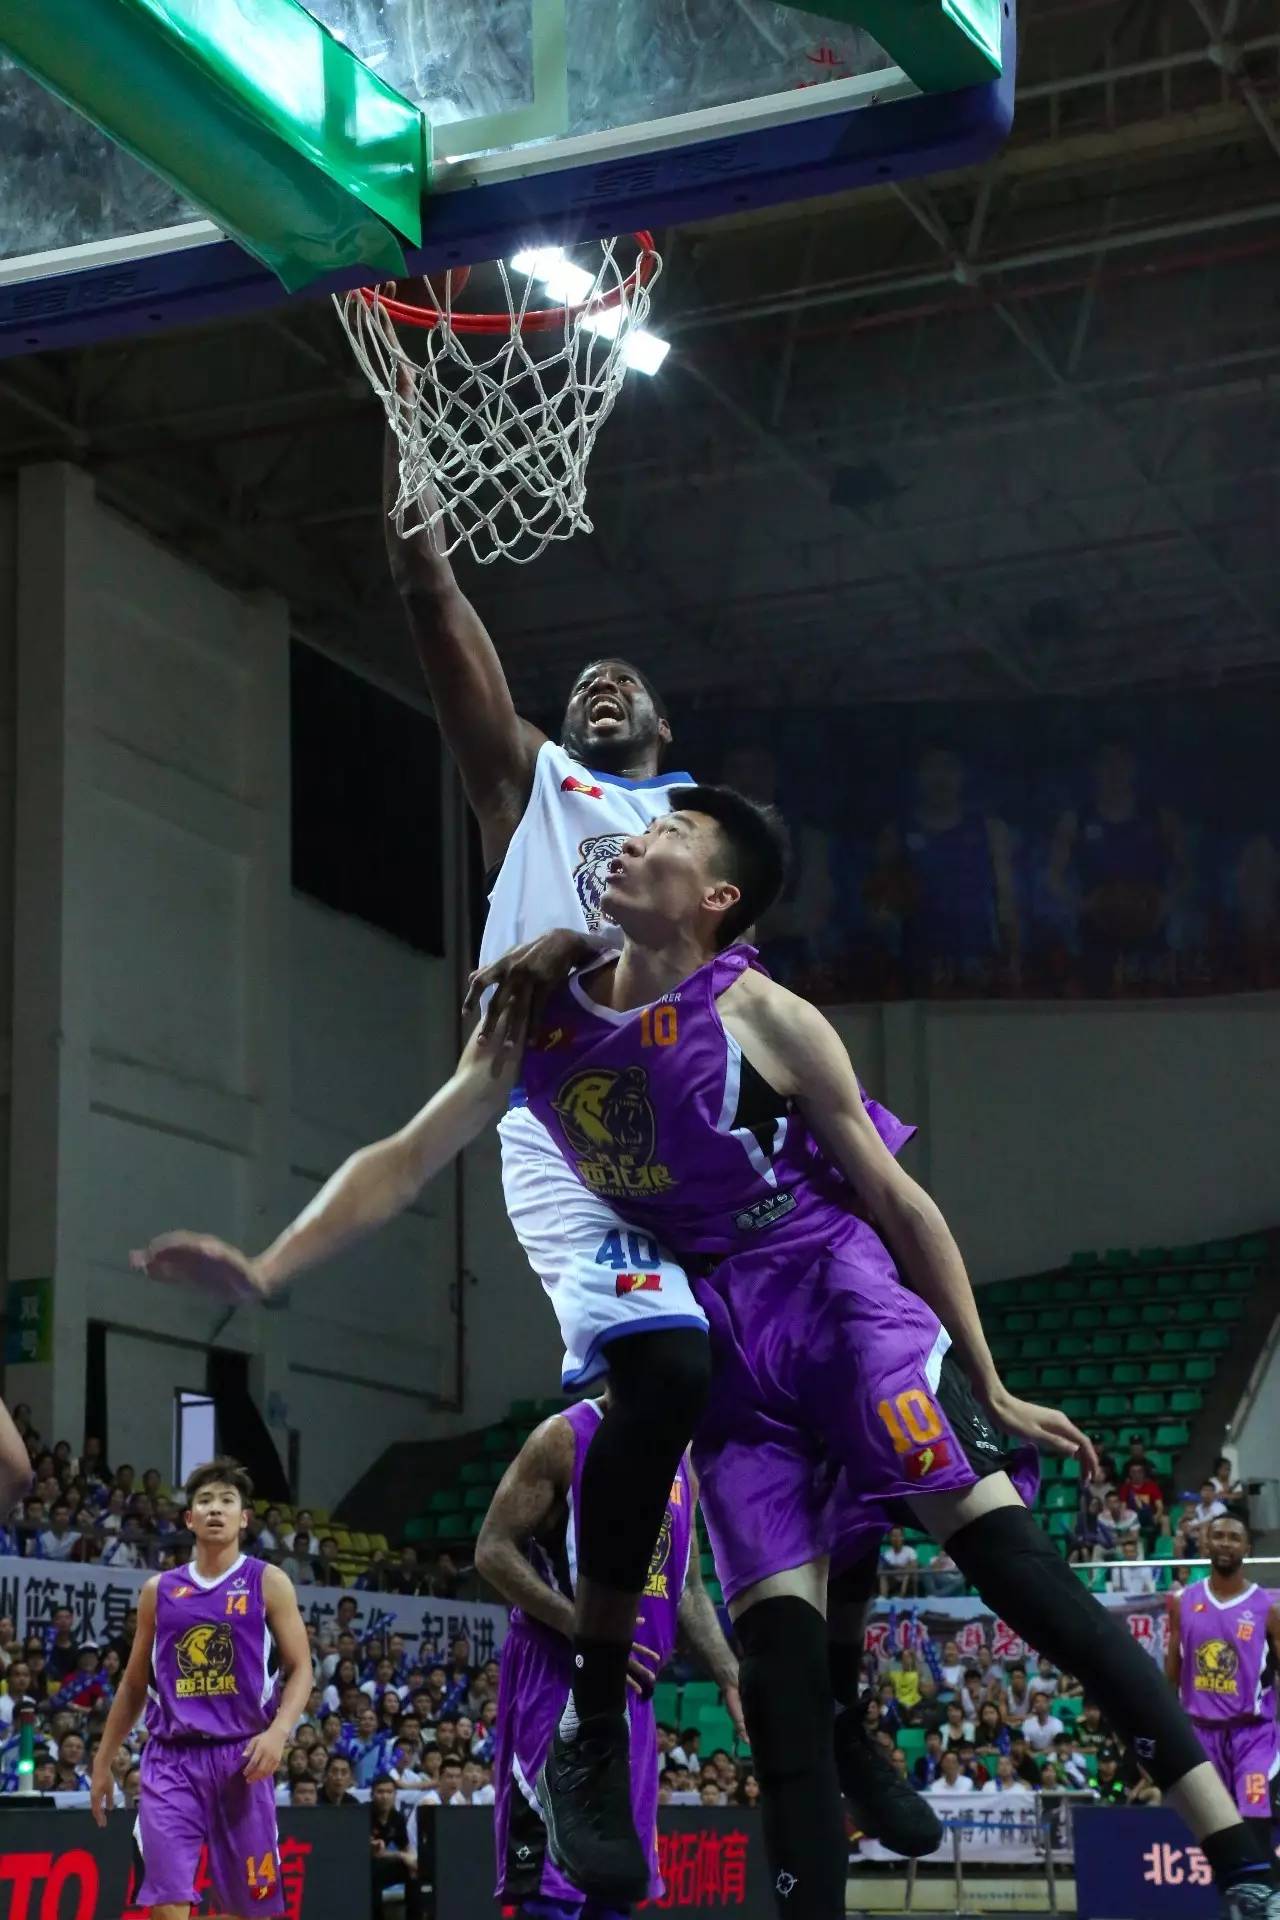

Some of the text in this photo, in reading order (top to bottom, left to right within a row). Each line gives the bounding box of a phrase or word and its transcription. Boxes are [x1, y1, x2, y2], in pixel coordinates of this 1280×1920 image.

[660, 992, 682, 1003] RER
[640, 1005, 678, 1048] 10
[595, 1228, 661, 1270] 40
[877, 1388, 943, 1454] 10
[225, 1595, 248, 1615] 14
[1246, 1774, 1266, 1794] 12
[246, 1852, 276, 1886] 14
[1143, 1843, 1212, 1885] 北京
